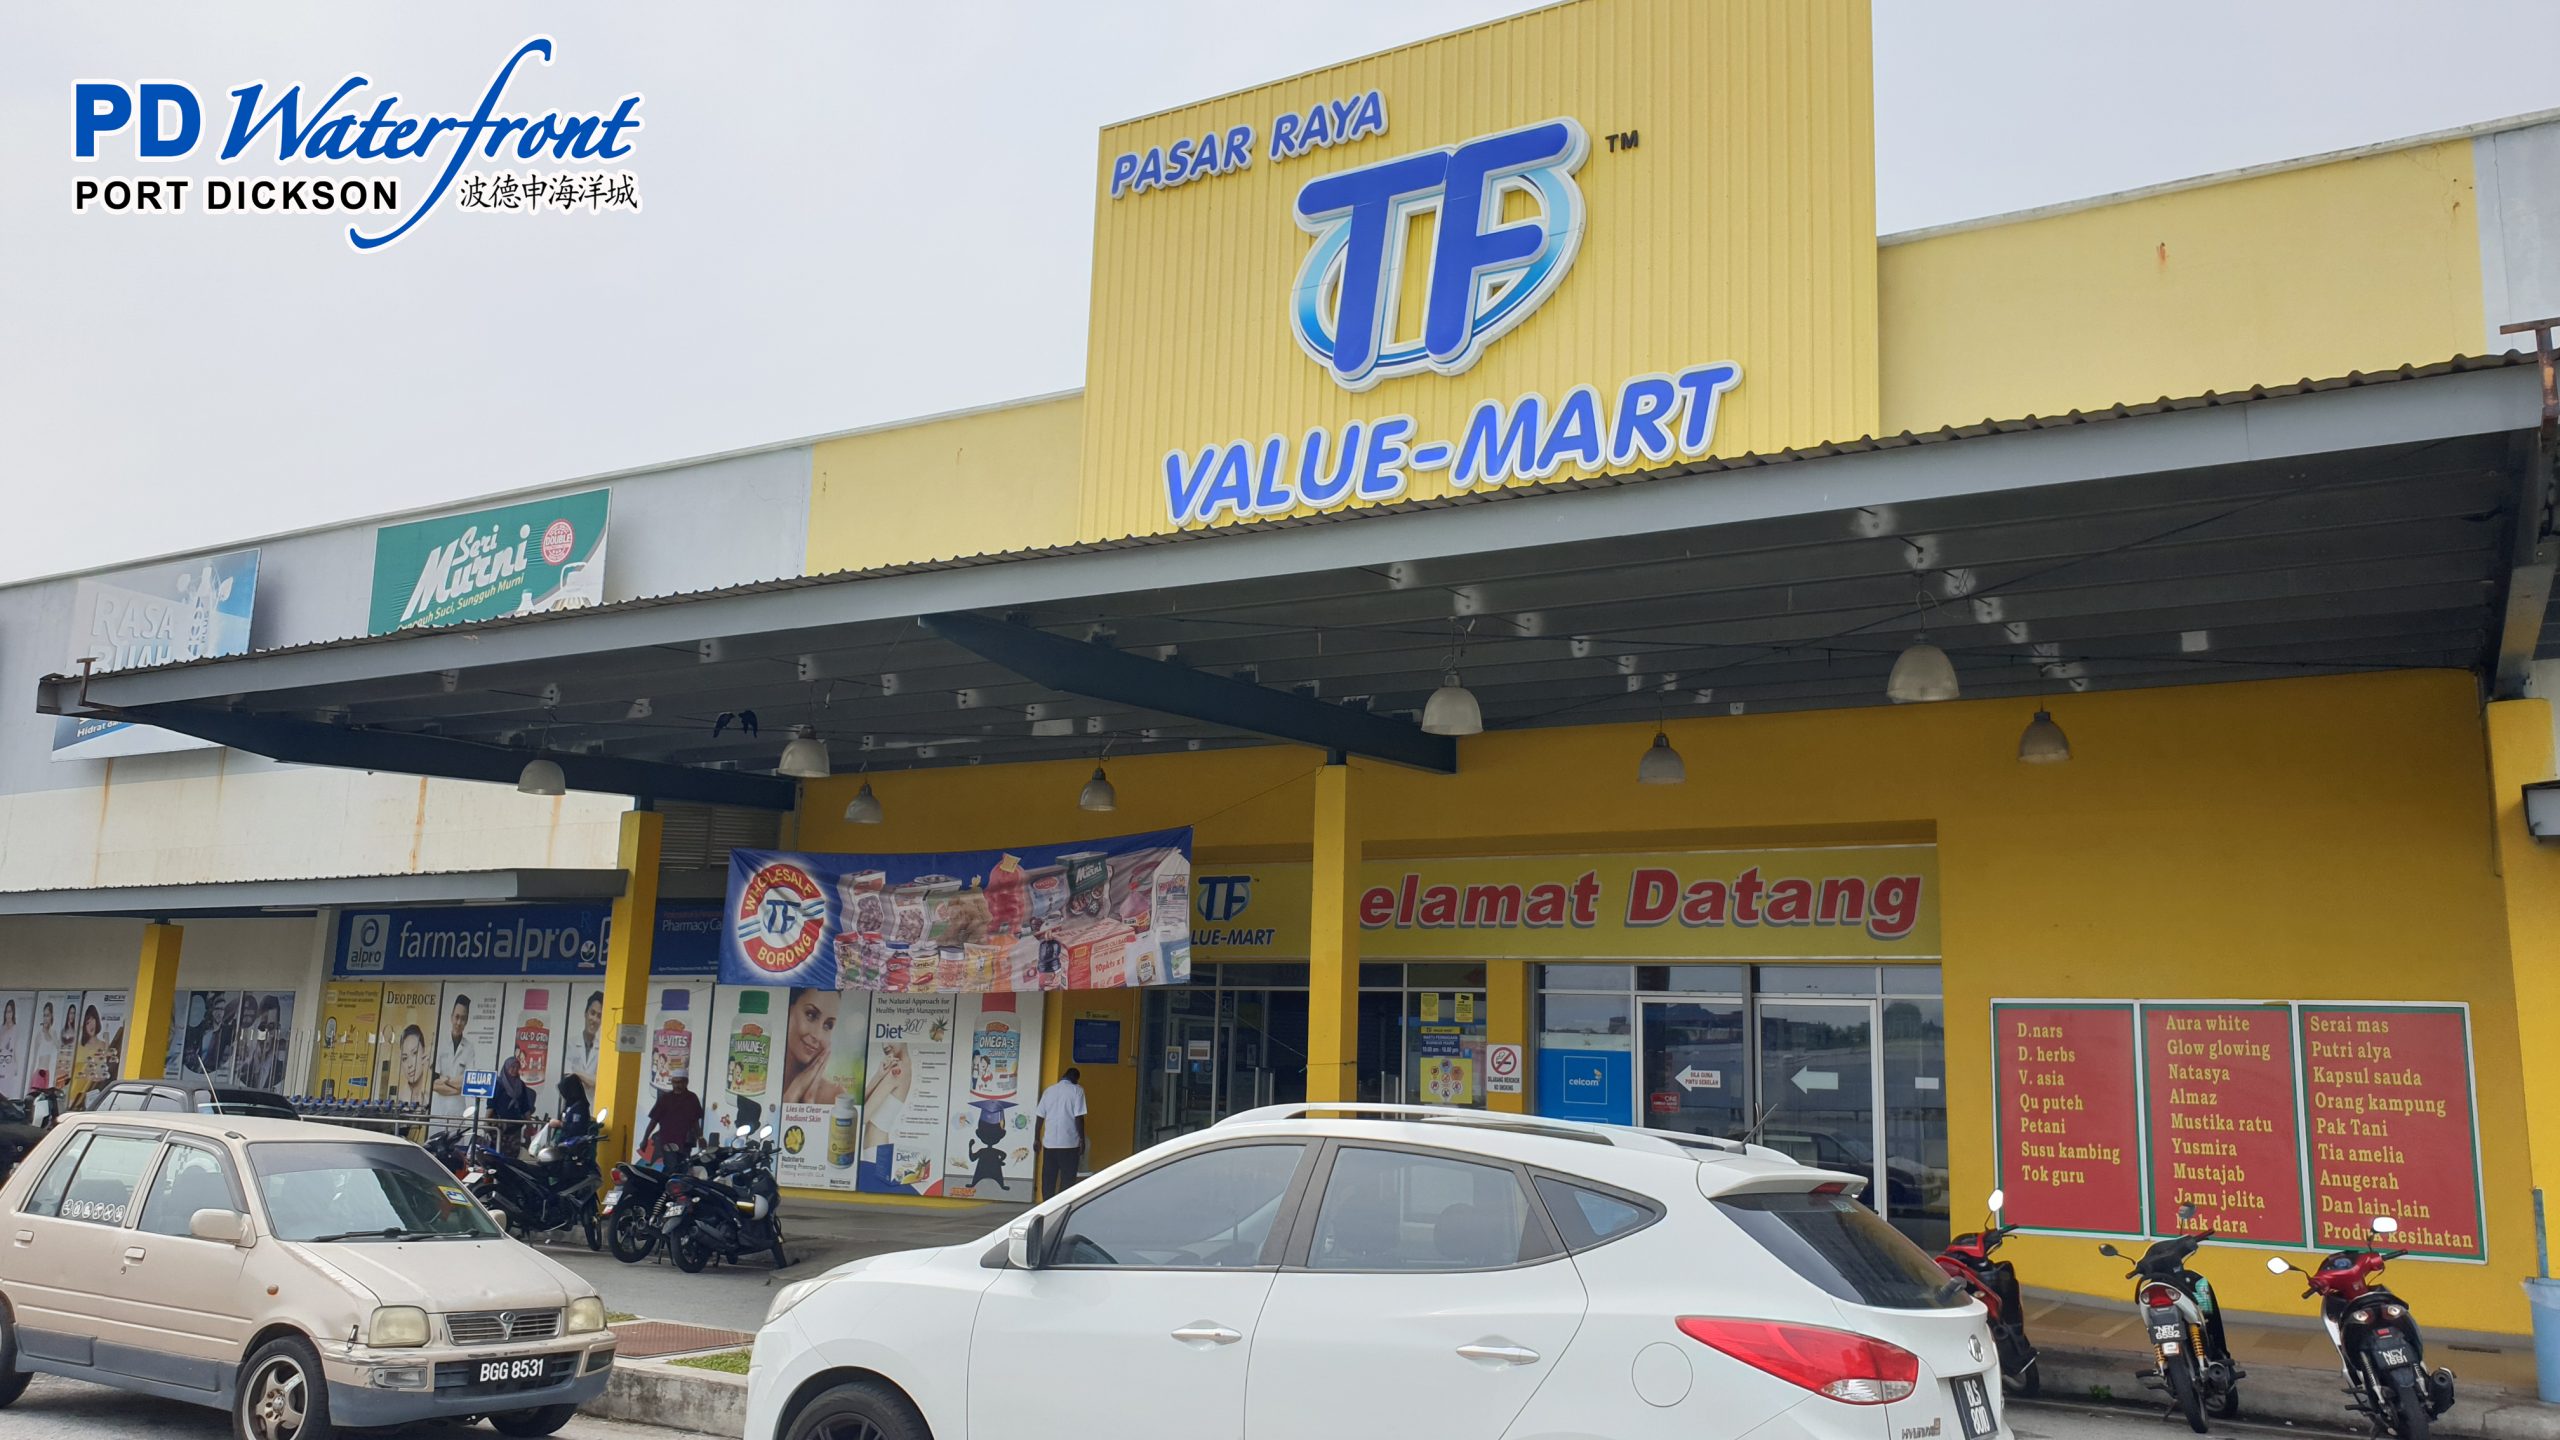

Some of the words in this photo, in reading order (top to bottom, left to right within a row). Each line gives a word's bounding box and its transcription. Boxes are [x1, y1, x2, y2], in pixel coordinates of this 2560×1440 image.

[1110, 125, 1254, 197] PASAR
[1271, 90, 1386, 157] RAYA
[1296, 120, 1572, 376] TF
[1164, 365, 1738, 522] VALUE-MART
[452, 525, 500, 566] Seri
[401, 524, 531, 622] Murni
[456, 588, 496, 610] Sungguh
[497, 573, 524, 594] Murni
[91, 590, 175, 646] RASA
[77, 722, 106, 737] Hidrat
[745, 868, 814, 912] WHOLESALE
[1198, 875, 1251, 921] TF
[1359, 870, 1600, 927] elamat
[1625, 867, 1922, 940] Datang
[662, 919, 708, 934] Pharmacy
[1190, 929, 1275, 946] LUE-MART
[351, 947, 381, 968] alpro
[757, 933, 812, 966] BORONG
[2166, 1015, 2202, 1031] Aura
[2206, 1015, 2250, 1031] white
[2310, 1016, 2352, 1032] Serai
[2357, 1020, 2389, 1033] mas
[2018, 1047, 2033, 1061] D.
[2037, 1047, 2075, 1062] herbs
[2167, 1039, 2204, 1055] Glow
[2209, 1040, 2271, 1061] glowing
[2311, 1041, 2353, 1058] Putri
[2357, 1043, 2392, 1063] alya
[466, 1072, 492, 1085] KELUAR
[1568, 1077, 1600, 1087] celcom
[2018, 1070, 2033, 1085] V.
[2037, 1070, 2064, 1086] asia
[2168, 1064, 2230, 1084] Natasya
[2313, 1066, 2369, 1087] Kapsul
[2374, 1069, 2423, 1086] sauda
[2020, 1094, 2039, 1112] Qu
[2043, 1095, 2083, 1113] puteh
[2170, 1088, 2218, 1105] Almaz
[2315, 1092, 2364, 1114] Orang
[2368, 1094, 2447, 1118] kampung
[2021, 1117, 2066, 1134] Petani
[2171, 1113, 2234, 1131] Mustika
[2239, 1115, 2273, 1132] ratu
[2316, 1118, 2347, 1135] Pak
[2350, 1119, 2389, 1137] Tani
[2022, 1141, 2055, 1158] Susu
[2059, 1142, 2120, 1165] kambing
[2171, 1138, 2237, 1156] Yusmira
[2318, 1143, 2344, 1161] Tia
[2349, 1146, 2405, 1164] amelia
[2022, 1165, 2048, 1181] Tok
[2052, 1170, 2084, 1186] guru
[2173, 1163, 2245, 1185] Mustajab
[2320, 1169, 2400, 1193] Anugerah
[2174, 1187, 2218, 1206] Jamu
[2220, 1190, 2266, 1211] jelita
[2322, 1195, 2353, 1214] Dan
[2358, 1197, 2430, 1219] lain-lain
[2212, 1215, 2249, 1234] dara
[479, 1361, 510, 1382] BGG
[511, 1358, 544, 1379] 8531
[1963, 1379, 1982, 1407] BLS
